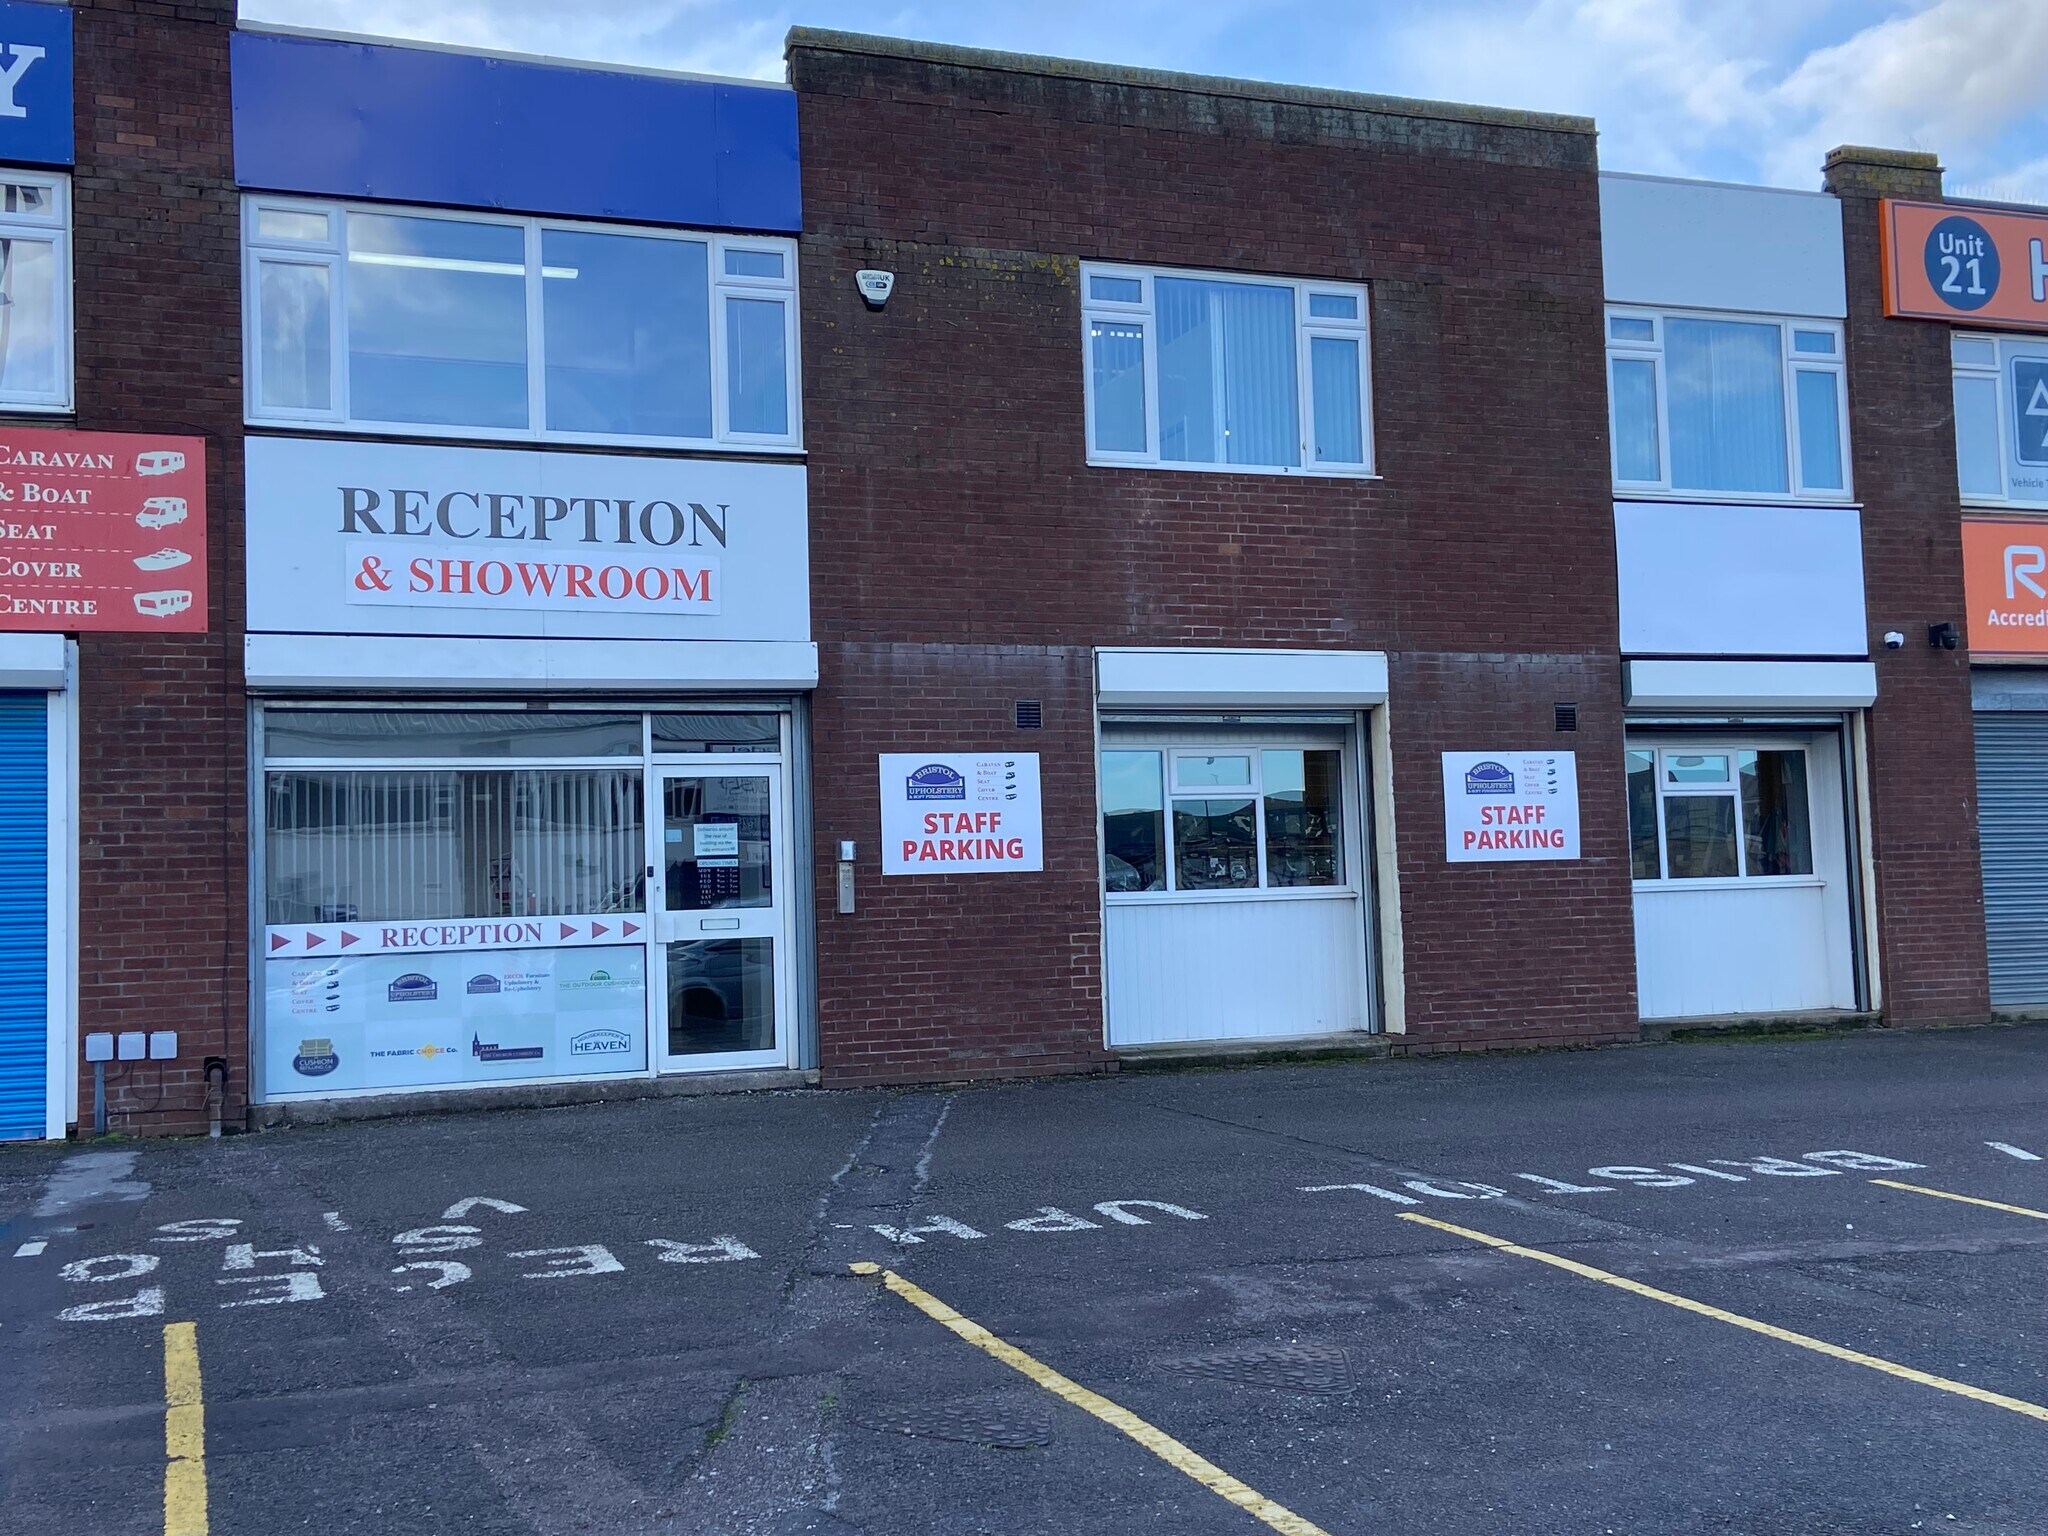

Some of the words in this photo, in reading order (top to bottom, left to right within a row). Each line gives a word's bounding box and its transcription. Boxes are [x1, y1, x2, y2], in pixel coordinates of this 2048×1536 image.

[1939, 233, 1985, 257] Unit
[1940, 256, 1987, 295] 21
[2011, 477, 2044, 488] Vehicle
[336, 486, 731, 549] RECEPTION
[354, 555, 393, 592] &
[409, 556, 714, 602] SHOWROOM
[915, 766, 955, 780] BRISTOL
[1472, 763, 1506, 775] BRISTOL
[909, 787, 964, 795] UPHOLSTERY
[924, 812, 1002, 835] STAFF
[1481, 805, 1545, 825] STAFF
[902, 838, 1024, 862] PARKING
[1463, 829, 1564, 850] PARKING
[381, 922, 543, 948] RECEPTION
[396, 975, 430, 986] BRISTOL
[416, 1047, 445, 1055] CHOICE
[299, 1058, 333, 1066] CUSHION
[1296, 1149, 1928, 1204] BRISTOL
